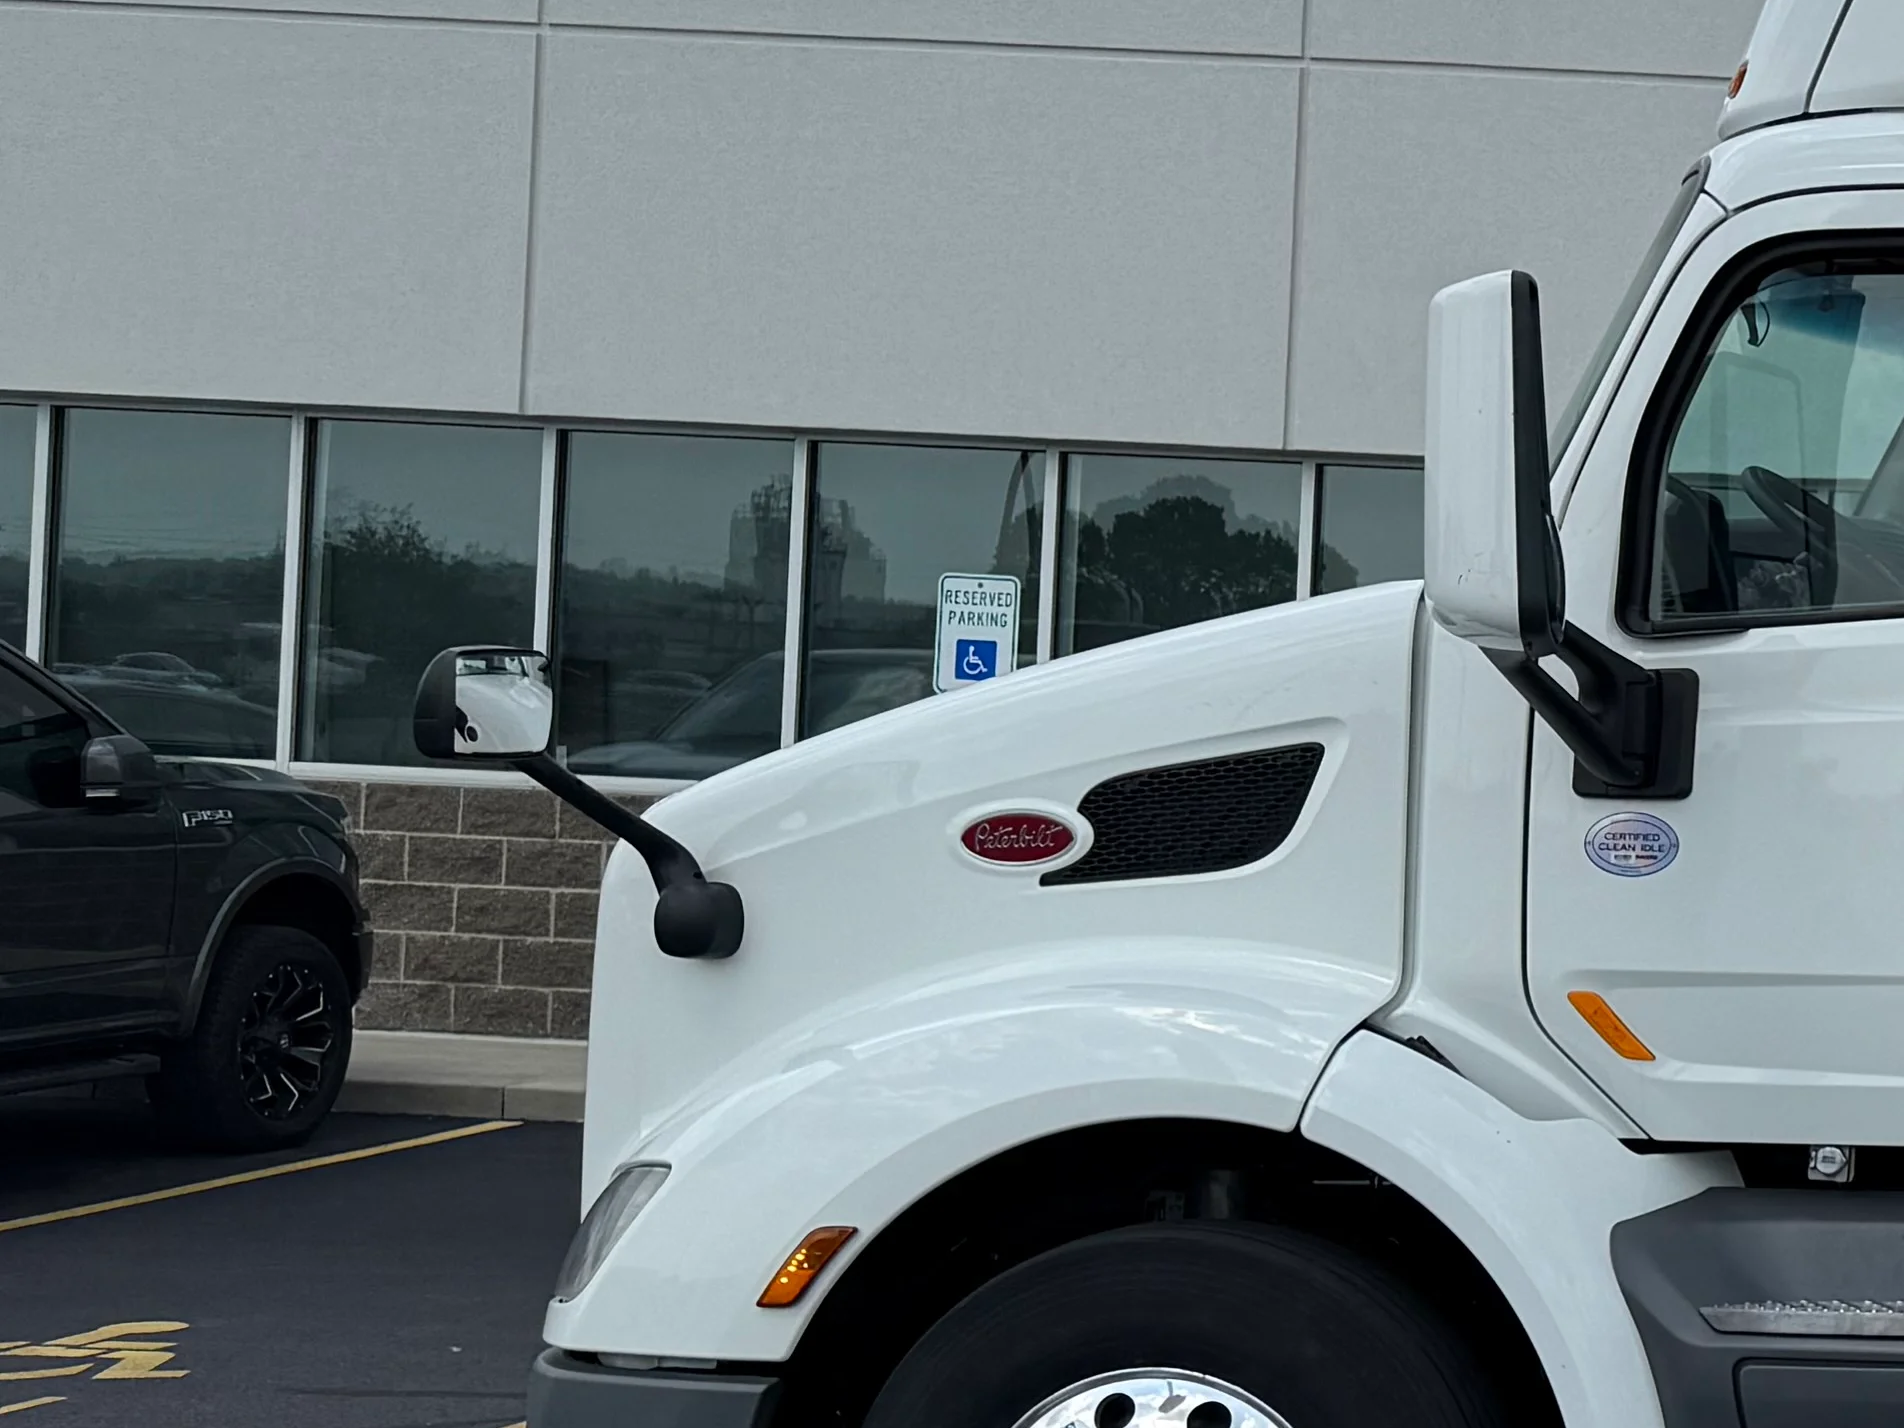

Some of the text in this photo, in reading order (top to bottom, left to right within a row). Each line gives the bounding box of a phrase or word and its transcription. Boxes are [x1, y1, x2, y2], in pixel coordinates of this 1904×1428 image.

[944, 590, 1012, 607] RESERVED
[948, 610, 1008, 628] PARKING
[975, 823, 1063, 852] Peterbilt
[1604, 832, 1660, 842] CERTIFIED
[1598, 842, 1665, 853] CLEAN IDLE
